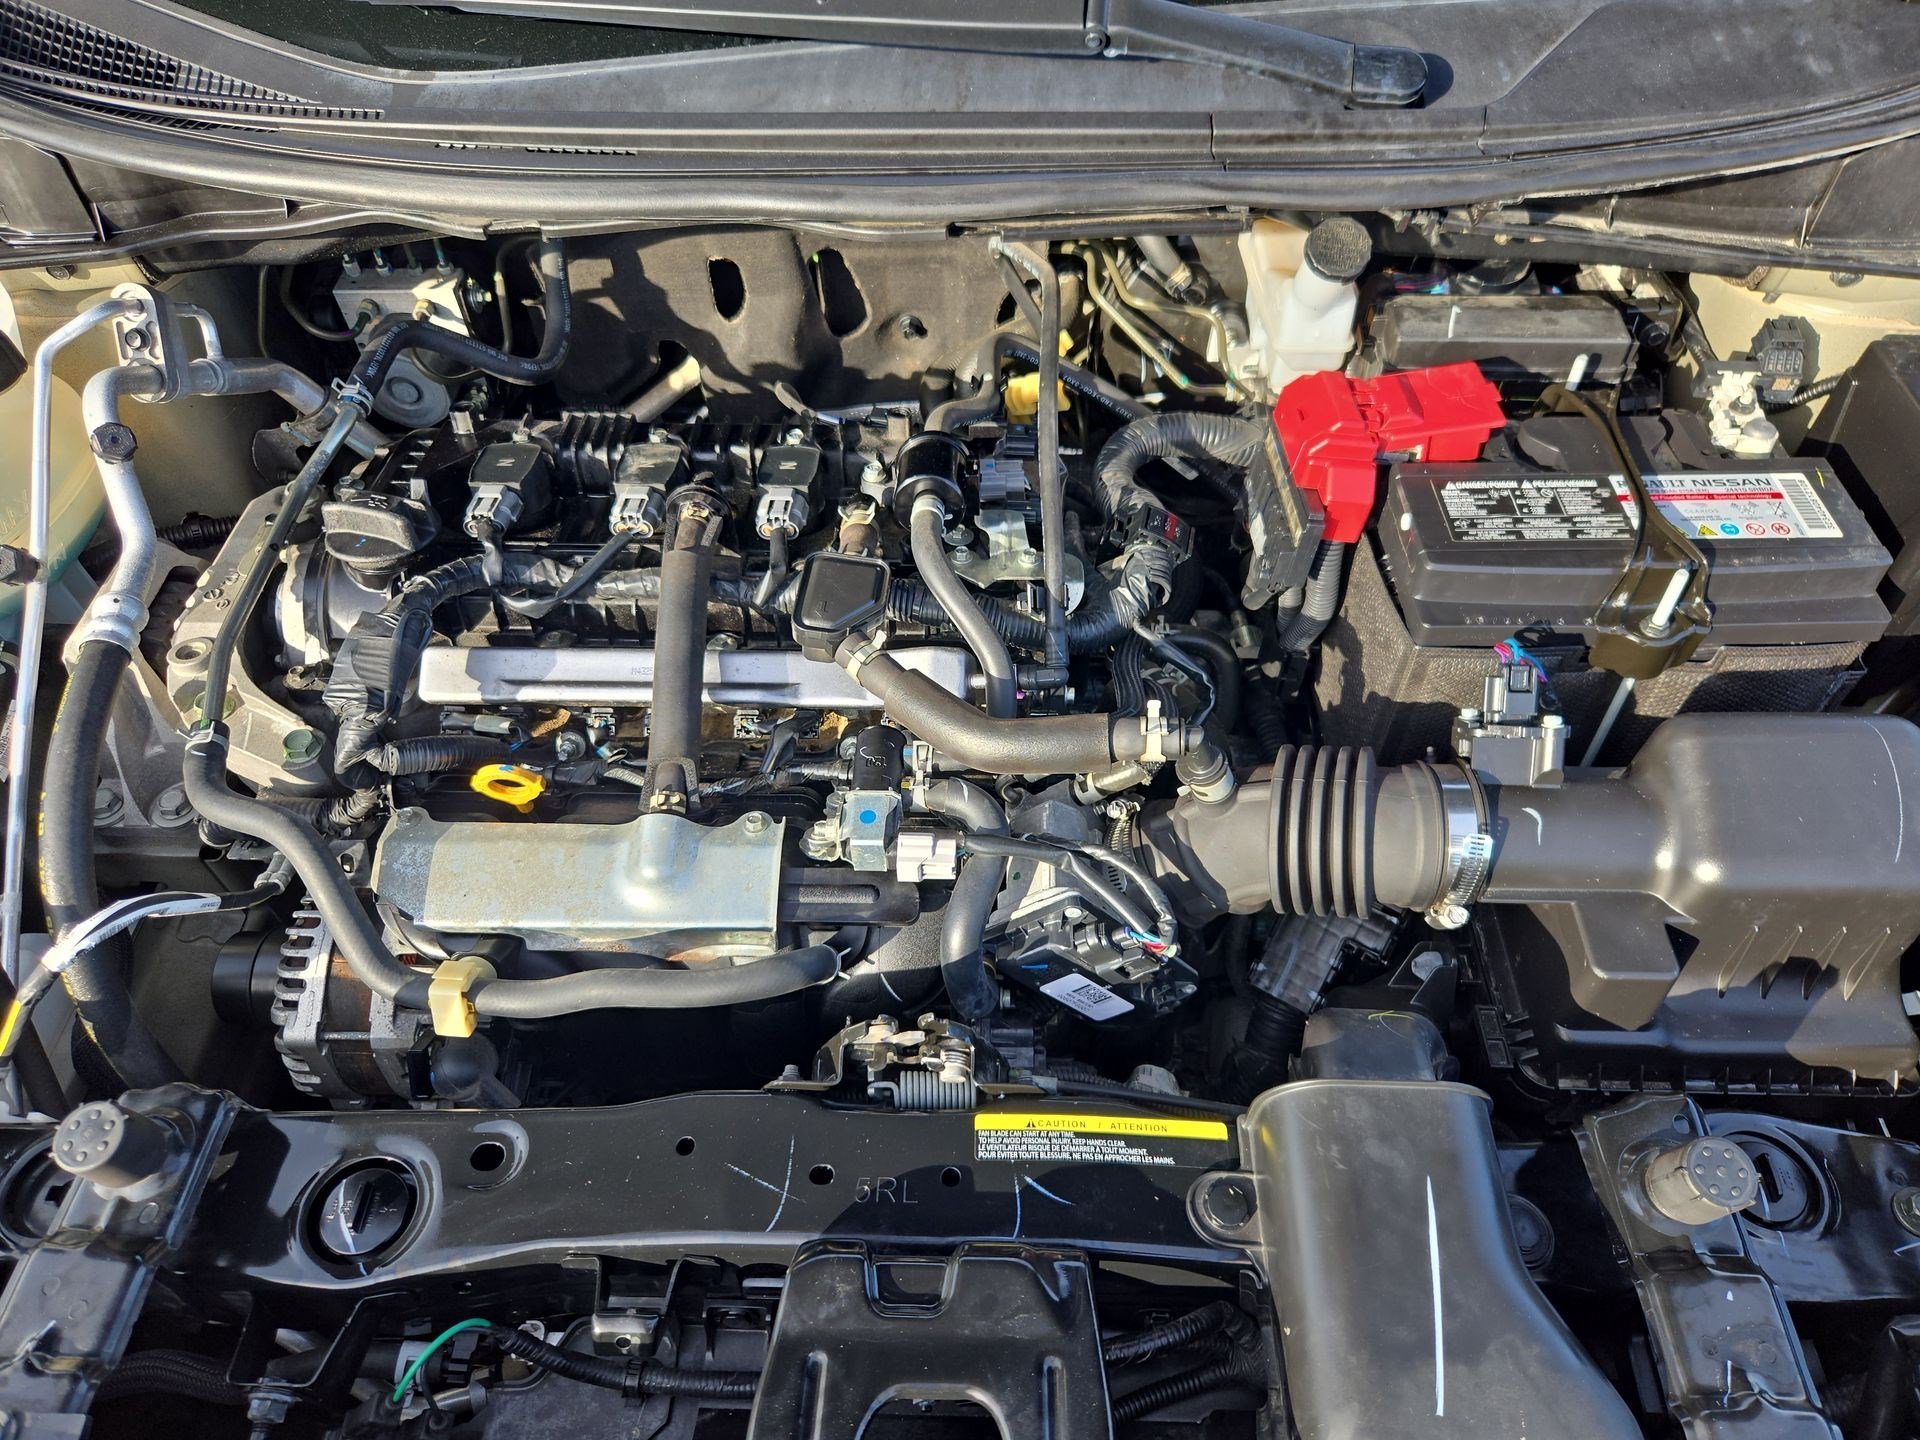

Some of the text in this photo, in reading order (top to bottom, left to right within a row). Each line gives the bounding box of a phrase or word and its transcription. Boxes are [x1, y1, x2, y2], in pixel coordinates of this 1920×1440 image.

[1691, 477, 1772, 487] NISSAN
[1037, 1119, 1086, 1128] CAUTION
[1110, 1122, 1168, 1132] ATTENTION
[1021, 1137, 1051, 1145] PERSONAL
[1072, 1138, 1086, 1146] KEEP
[1086, 1138, 1107, 1146] HANDS
[1028, 1144, 1051, 1152] RISQUE
[1101, 1146, 1118, 1154] TOUT
[978, 1151, 997, 1159] POUR
[1019, 1151, 1039, 1159] TOUTE
[1094, 1153, 1104, 1161] EN
[1104, 1154, 1142, 1162] APPROCHER
[1142, 1155, 1153, 1163] LES
[855, 1176, 919, 1203] 5RL
